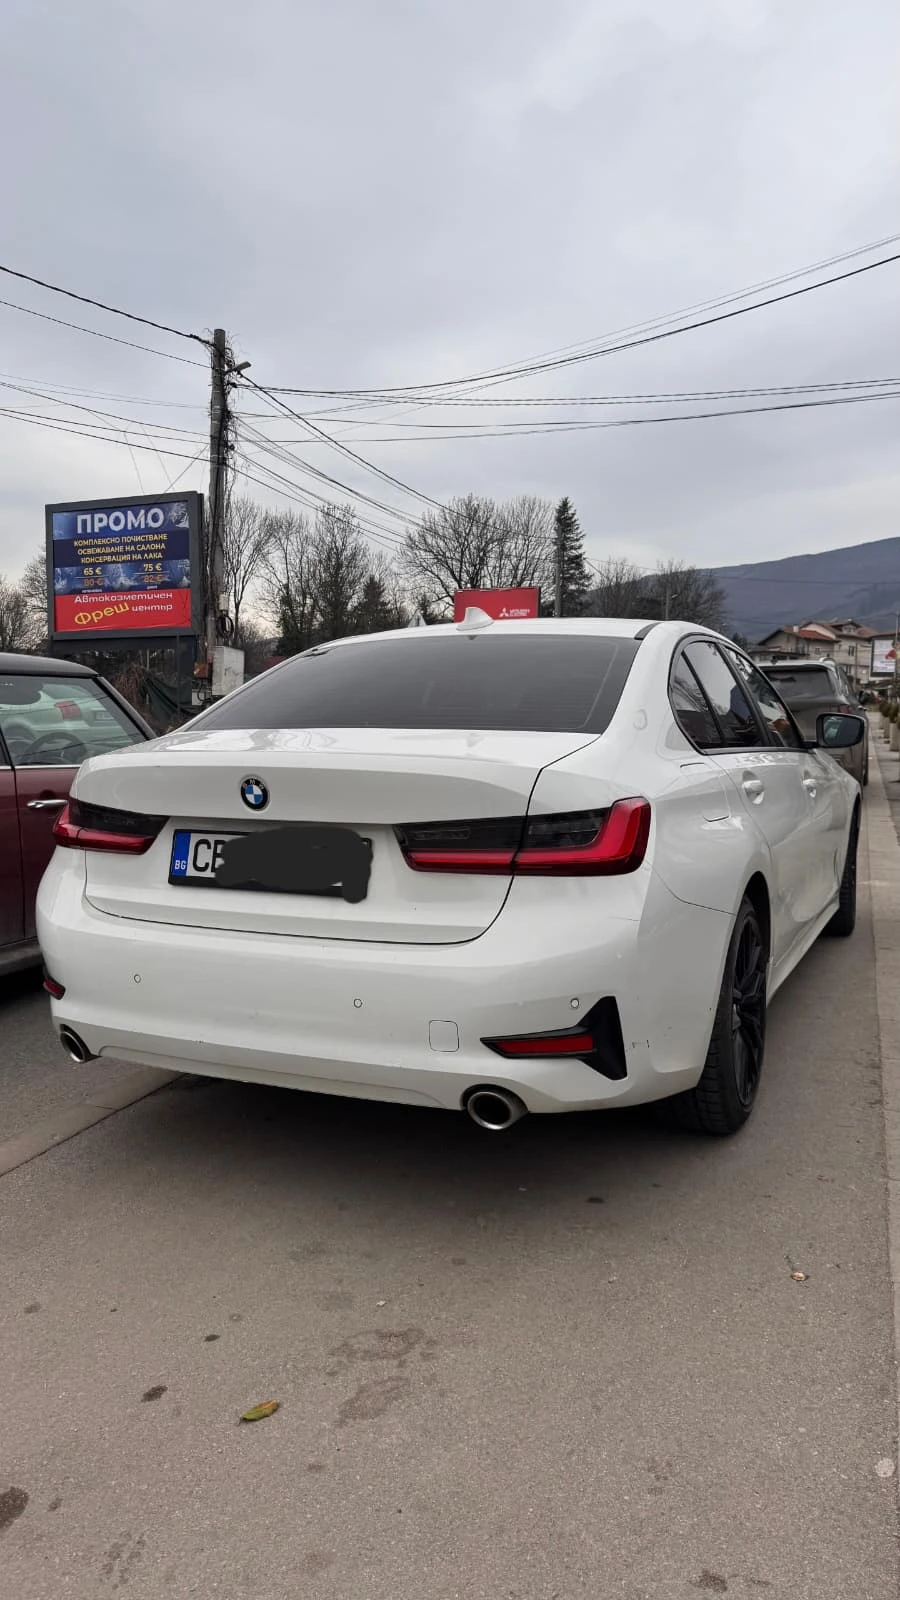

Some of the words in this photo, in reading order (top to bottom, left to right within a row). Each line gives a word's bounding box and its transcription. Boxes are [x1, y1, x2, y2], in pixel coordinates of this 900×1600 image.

[76, 508, 164, 534] ПРОМО
[74, 536, 120, 546] КОМПЛЕКСНО
[122, 534, 168, 542] ПОЧИСТВАНЕ
[78, 546, 124, 554] ОСВЕЖАВАНЕ
[136, 542, 166, 550] САЛОНА
[82, 554, 130, 564] КОНСЕРВАЦИЯ
[84, 568, 92, 576] 65
[74, 592, 172, 604] Автокозметичен
[74, 602, 130, 624] Фреш
[174, 860, 186, 870] BG
